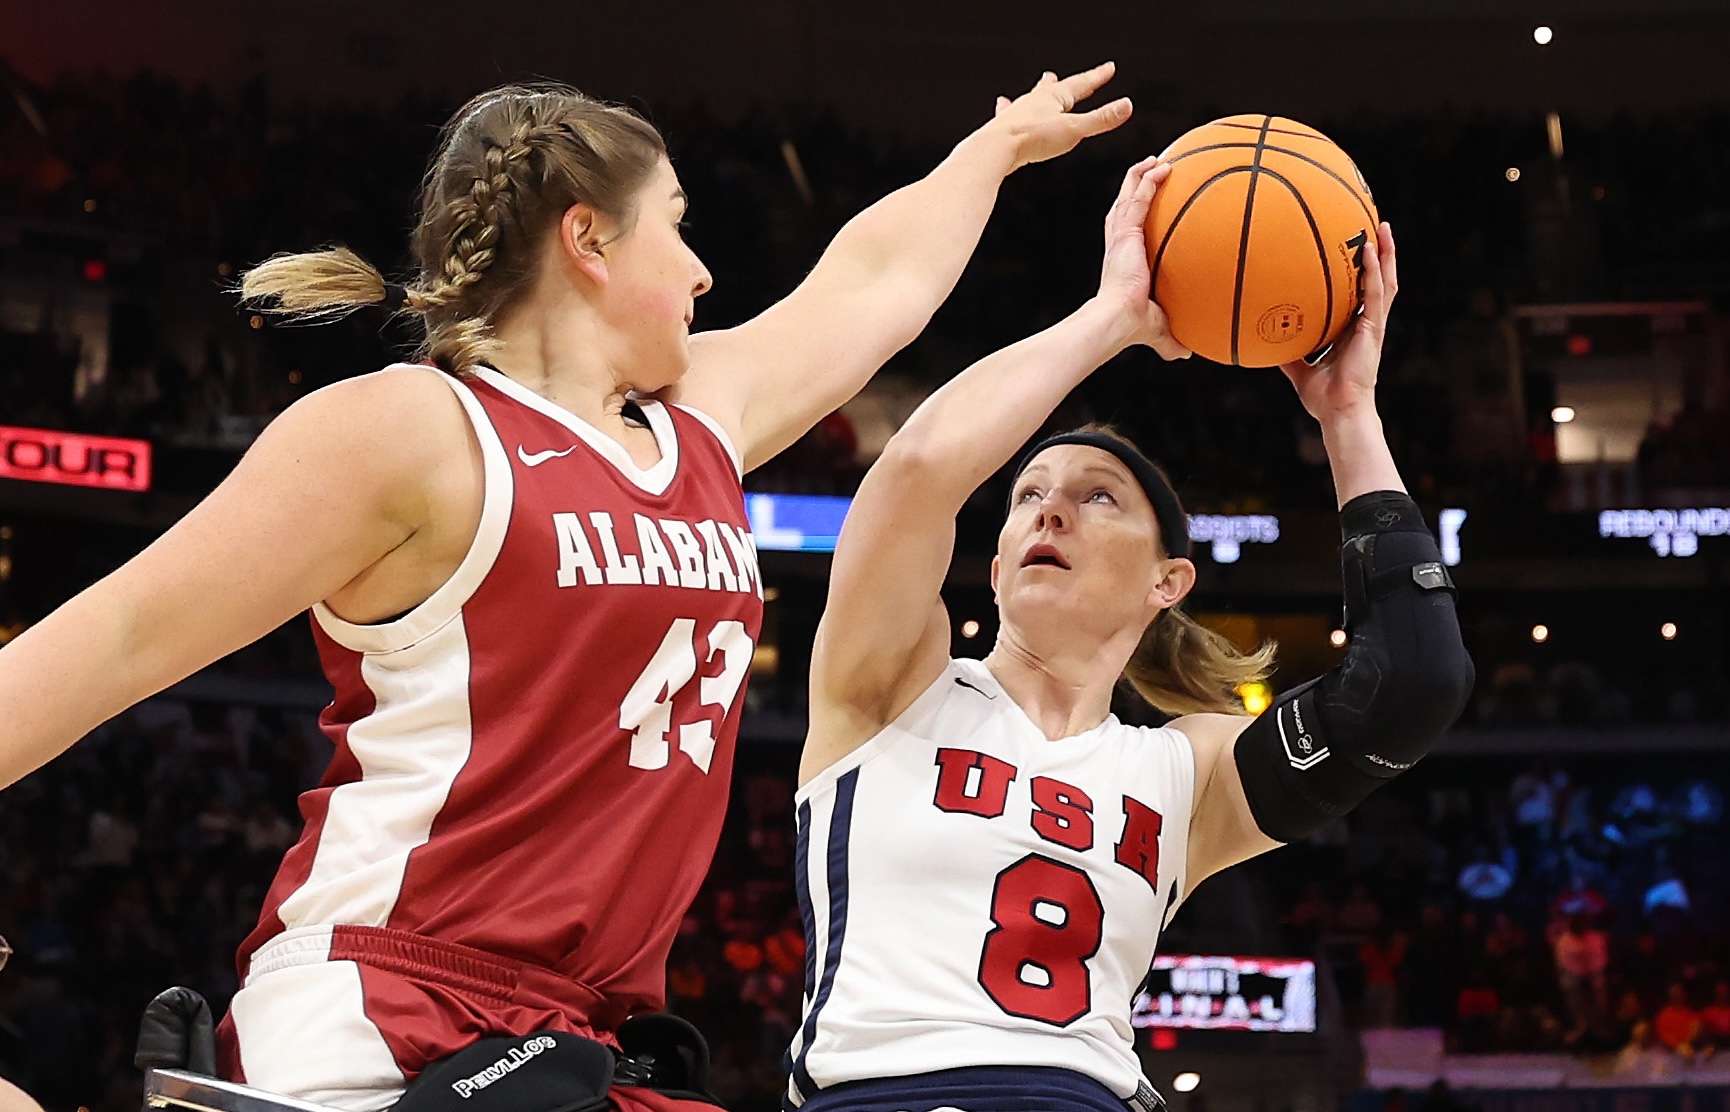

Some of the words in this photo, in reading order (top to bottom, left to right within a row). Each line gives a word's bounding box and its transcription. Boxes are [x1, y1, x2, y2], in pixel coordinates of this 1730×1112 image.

[618, 617, 755, 776] 43
[932, 747, 1164, 897] USA
[977, 851, 1106, 1029] 8
